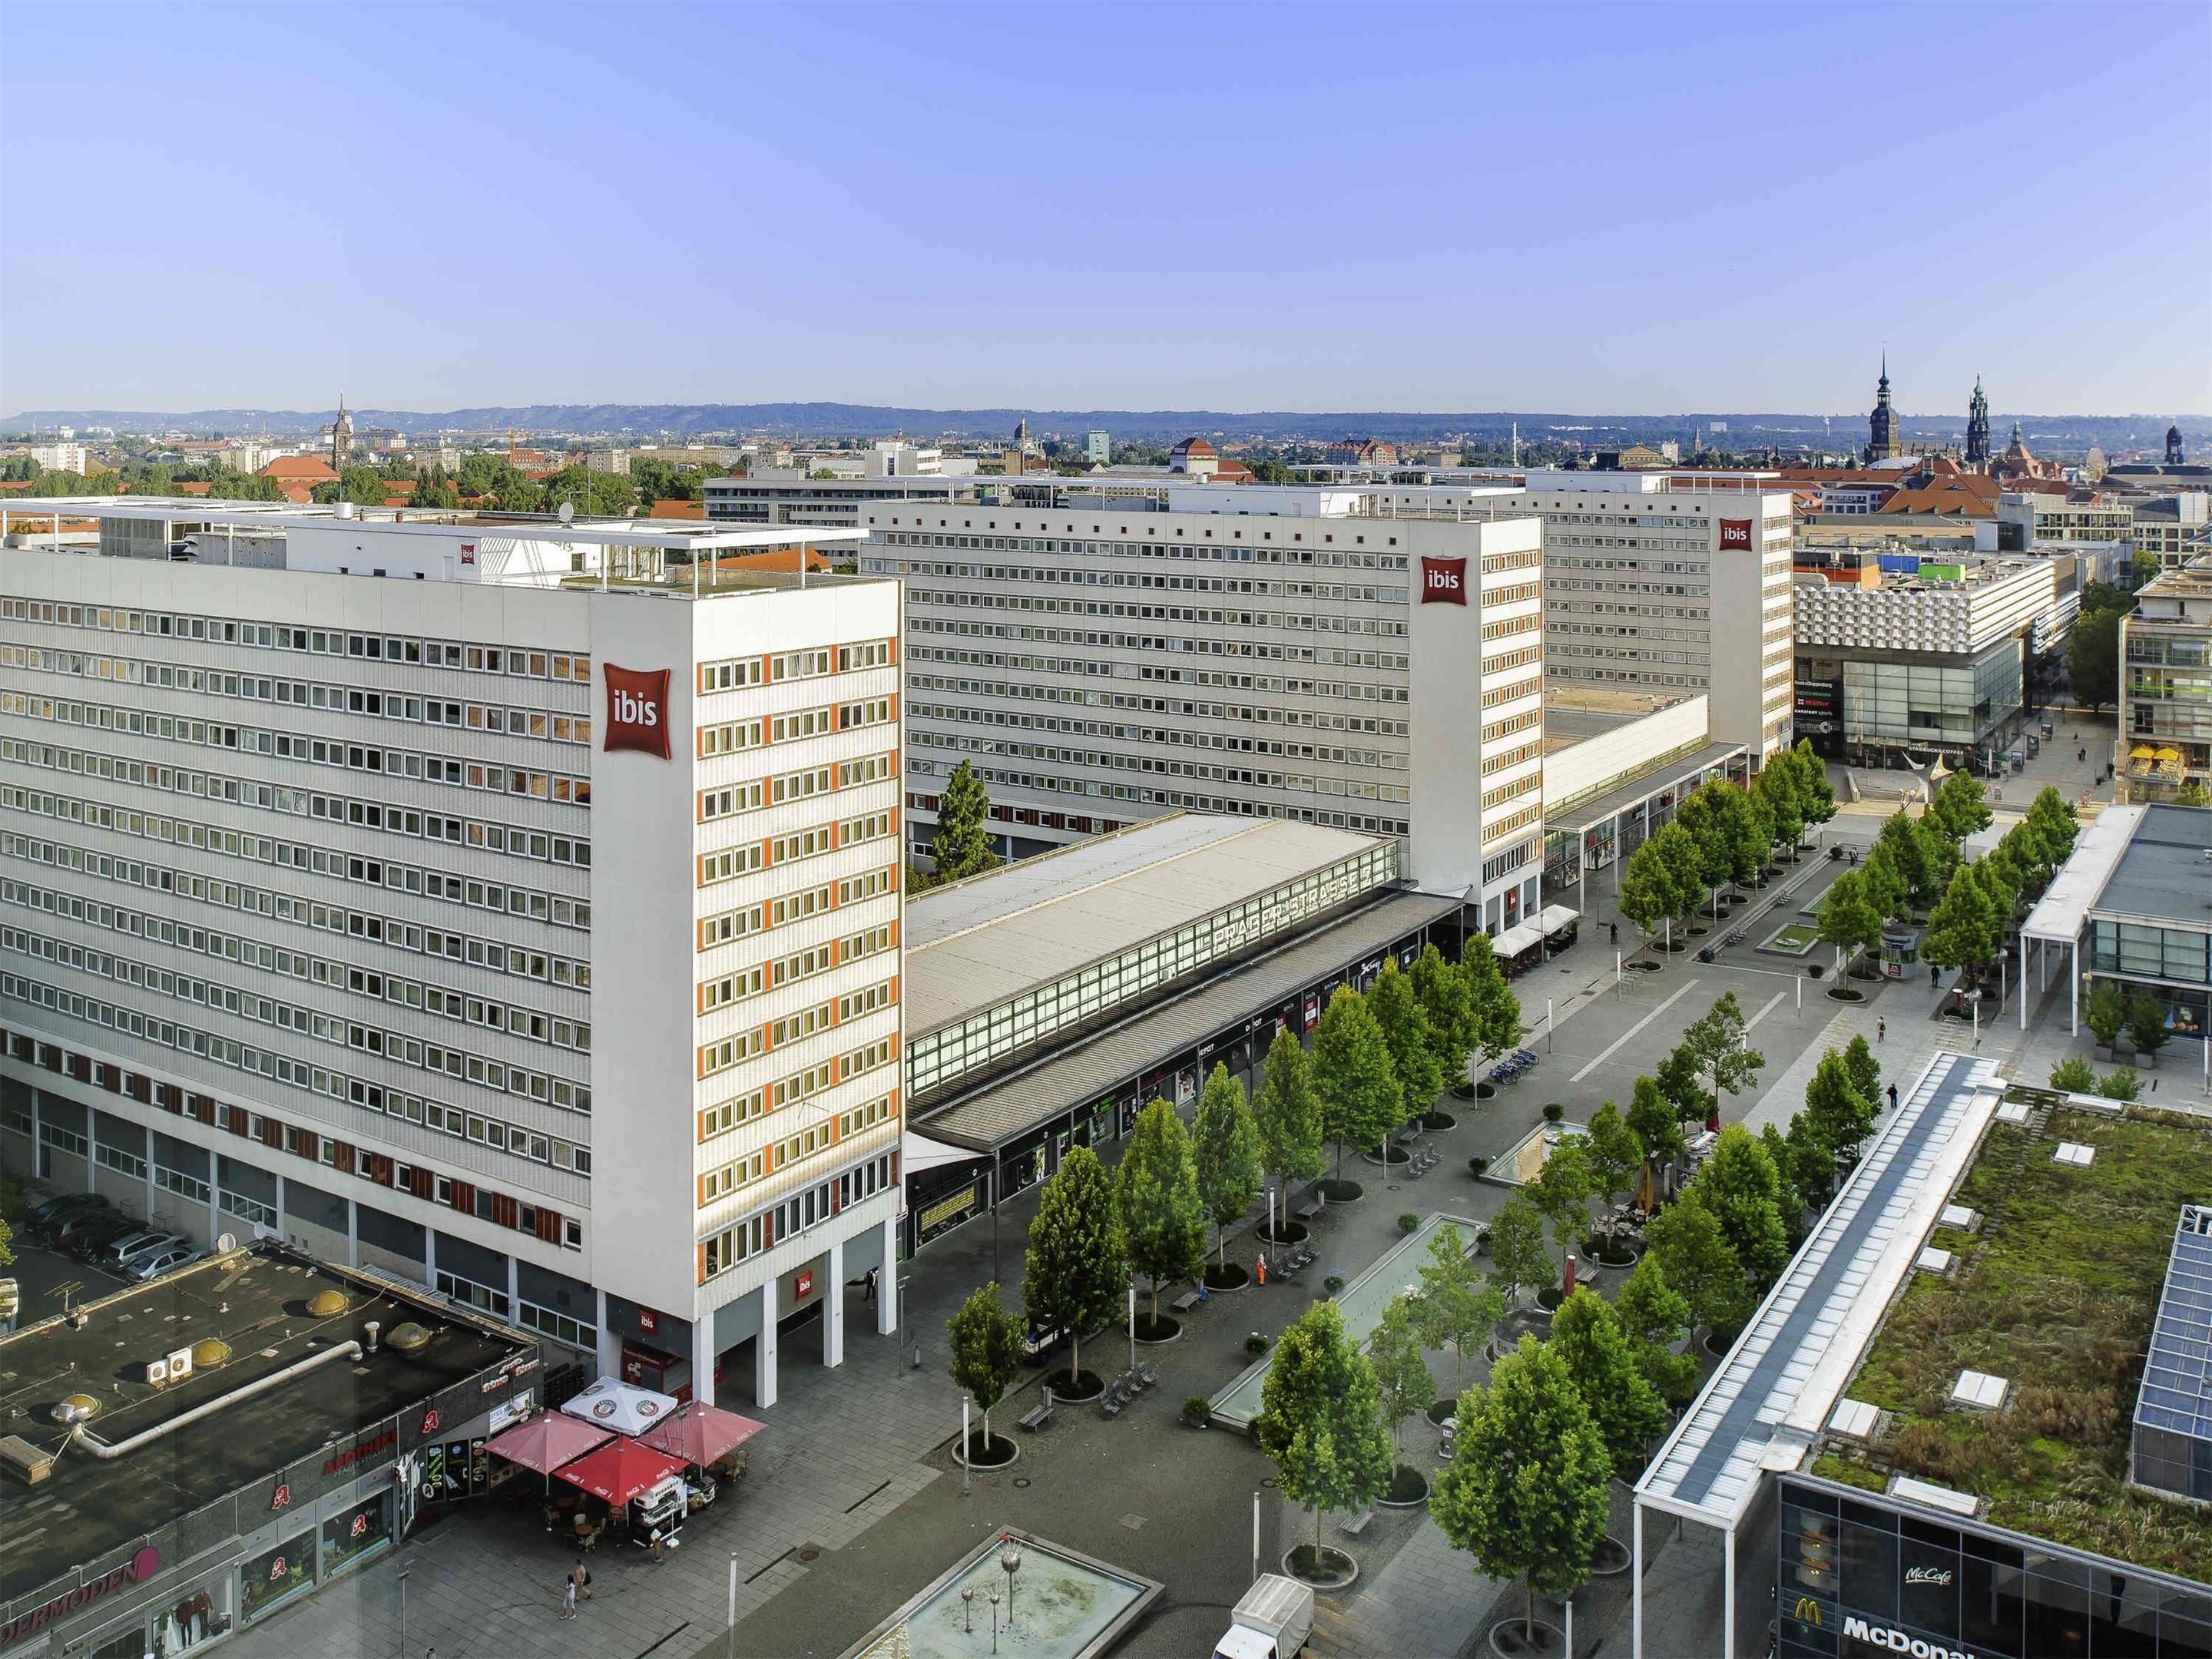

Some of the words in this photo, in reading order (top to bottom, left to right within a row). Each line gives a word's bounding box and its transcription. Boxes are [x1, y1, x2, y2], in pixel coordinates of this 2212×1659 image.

[1724, 527, 1747, 541] ibis
[1429, 569, 1459, 589] ibis
[614, 689, 657, 727] ibis
[800, 1280, 811, 1292] ibis
[641, 1316, 654, 1329] ibis
[323, 1426, 397, 1475] APOTHEKE
[1906, 1567, 1952, 1585] McCafé
